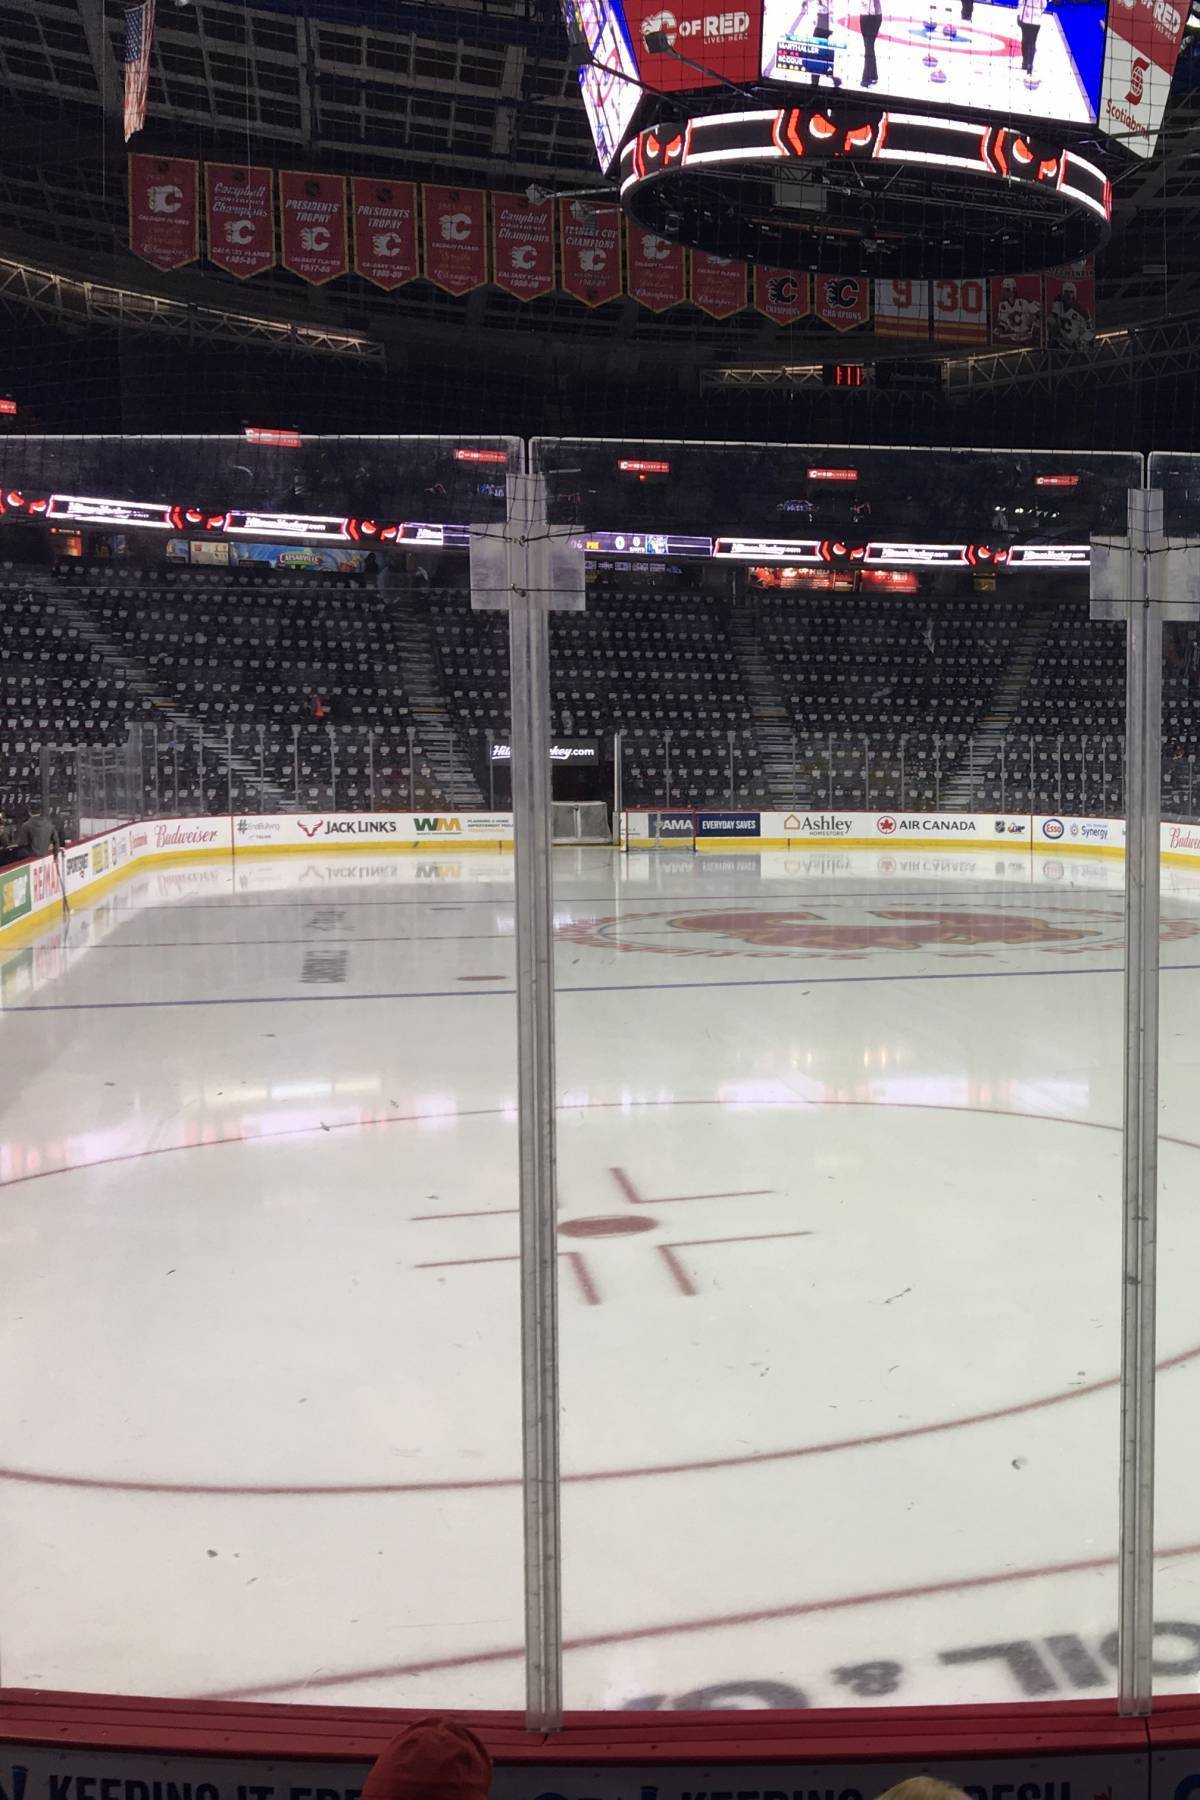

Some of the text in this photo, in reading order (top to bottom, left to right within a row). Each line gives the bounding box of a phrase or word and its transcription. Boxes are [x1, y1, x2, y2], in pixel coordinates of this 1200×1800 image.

[679, 20, 702, 37] OF
[703, 11, 750, 37] RED
[1152, 1, 1181, 34] RED
[704, 37, 725, 45] LIVES
[285, 199, 340, 213] PRESIDENTS
[357, 205, 410, 219] PRESIDENTS
[500, 209, 547, 225] Campbell
[498, 228, 549, 243] Champions
[565, 236, 616, 249] CHAMPIONS
[891, 280, 913, 309] 9
[936, 281, 983, 314] 30
[324, 820, 356, 835] JACK
[413, 817, 463, 832] WM
[662, 819, 693, 830] AMA
[702, 820, 757, 831] EVERYDAY SAVES
[801, 815, 853, 834] Ashley
[899, 820, 976, 832] AIR CANADA
[1046, 823, 1061, 833] Esso
[1081, 824, 1109, 840] Synergy
[154, 824, 219, 849] Budweiser
